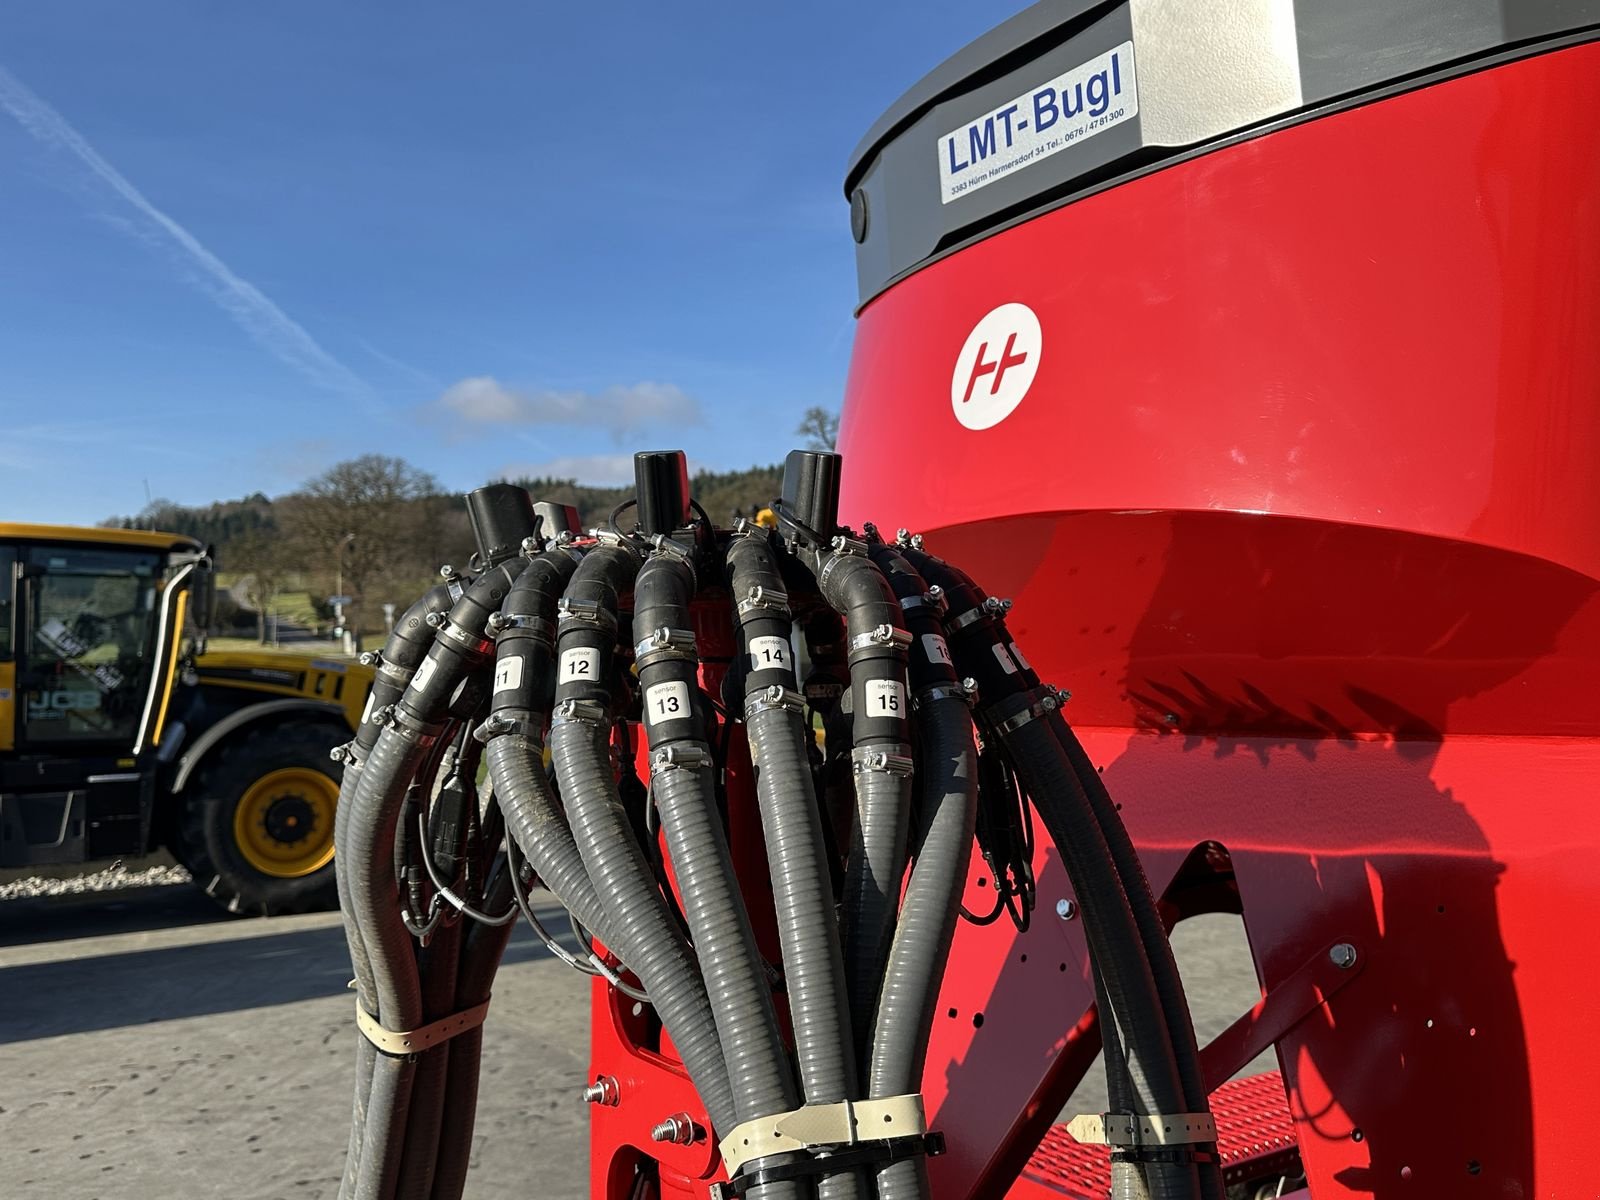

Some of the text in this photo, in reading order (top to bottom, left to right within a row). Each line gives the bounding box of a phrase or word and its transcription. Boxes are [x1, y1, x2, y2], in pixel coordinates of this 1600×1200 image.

[948, 53, 1121, 175] LMT-Bugl
[951, 182, 968, 195] 3383
[989, 150, 1034, 178] Harmersdorf
[1035, 145, 1045, 157] 34
[762, 648, 784, 663] 14
[568, 660, 589, 675] 12
[654, 685, 677, 695] sensor
[657, 696, 680, 714] 13
[878, 694, 899, 711] 15
